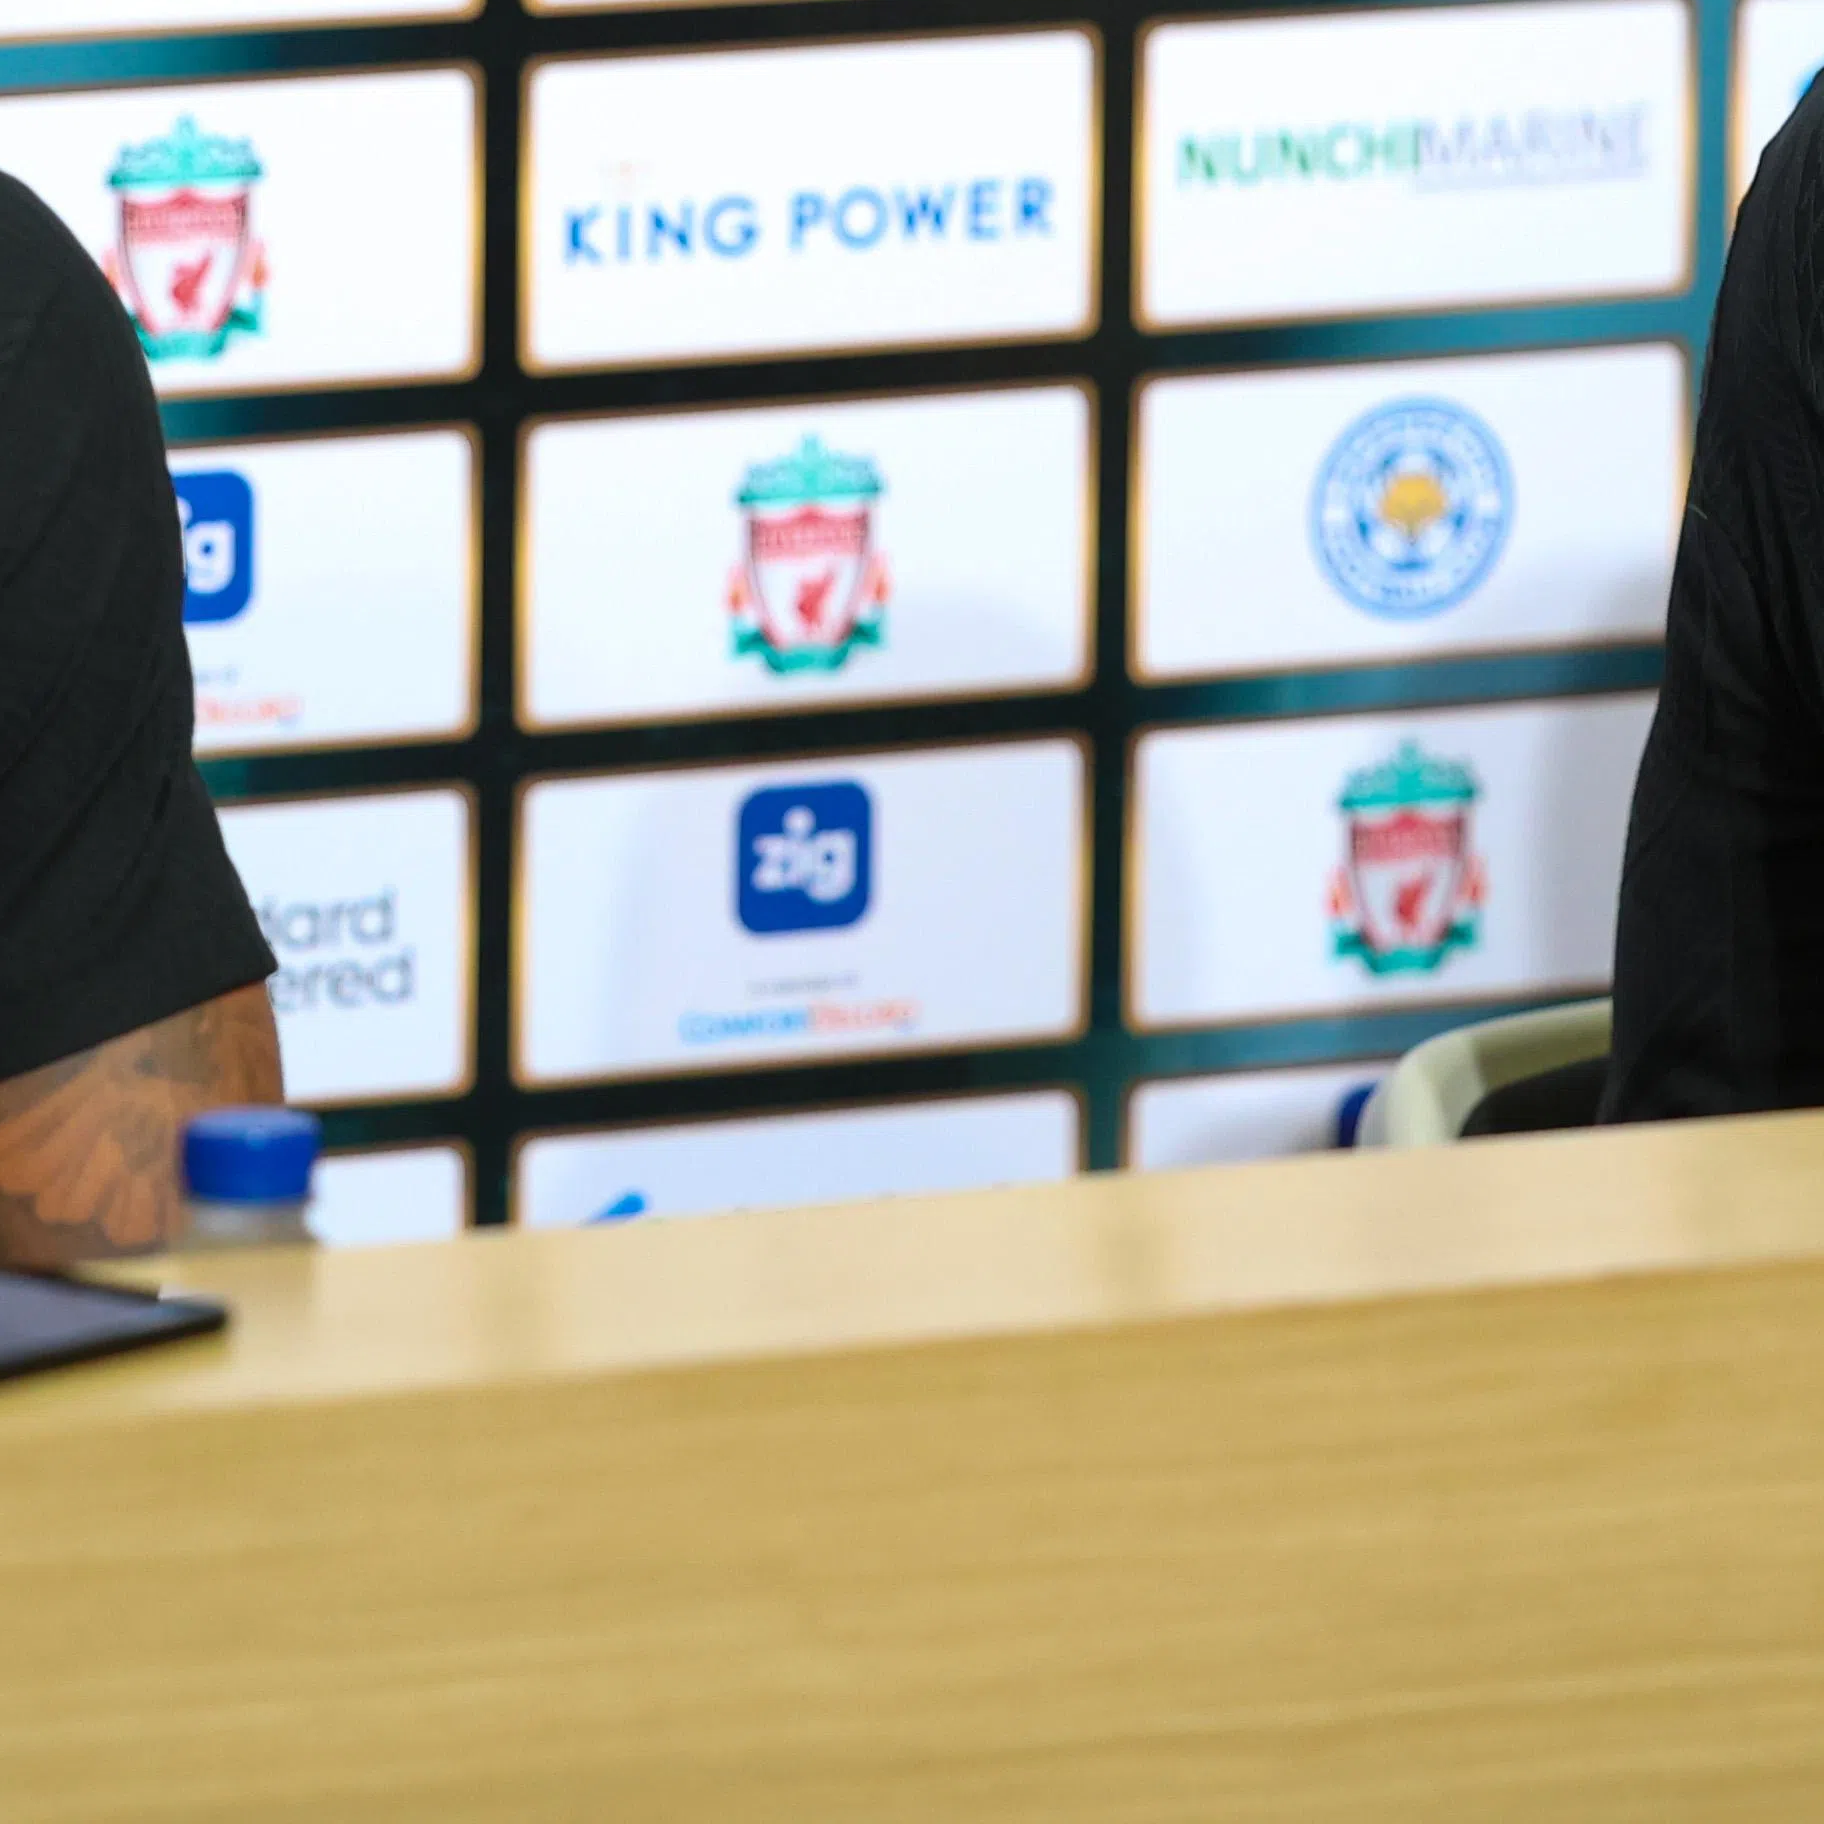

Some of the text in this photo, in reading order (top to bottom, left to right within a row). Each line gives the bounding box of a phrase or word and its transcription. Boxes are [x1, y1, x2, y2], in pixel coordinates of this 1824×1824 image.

[563, 179, 1056, 270] KING POWER
[753, 808, 860, 904] zig
